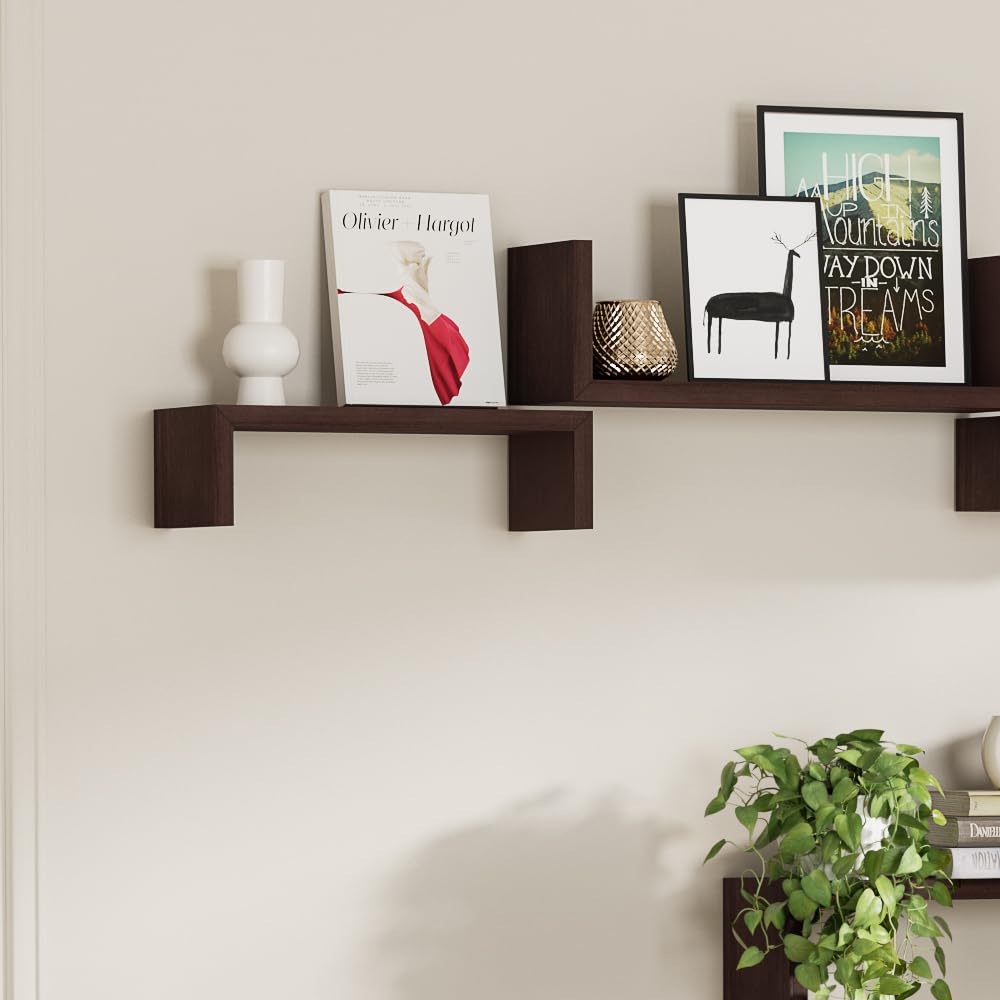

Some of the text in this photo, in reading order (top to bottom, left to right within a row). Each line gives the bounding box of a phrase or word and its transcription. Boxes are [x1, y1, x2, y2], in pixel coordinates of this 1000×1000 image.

[821, 151, 912, 202] HIGH
[342, 211, 399, 230] Olivier
[826, 202, 912, 220] UP IN
[865, 255, 933, 280] DOWN
[861, 277, 878, 288] IN
